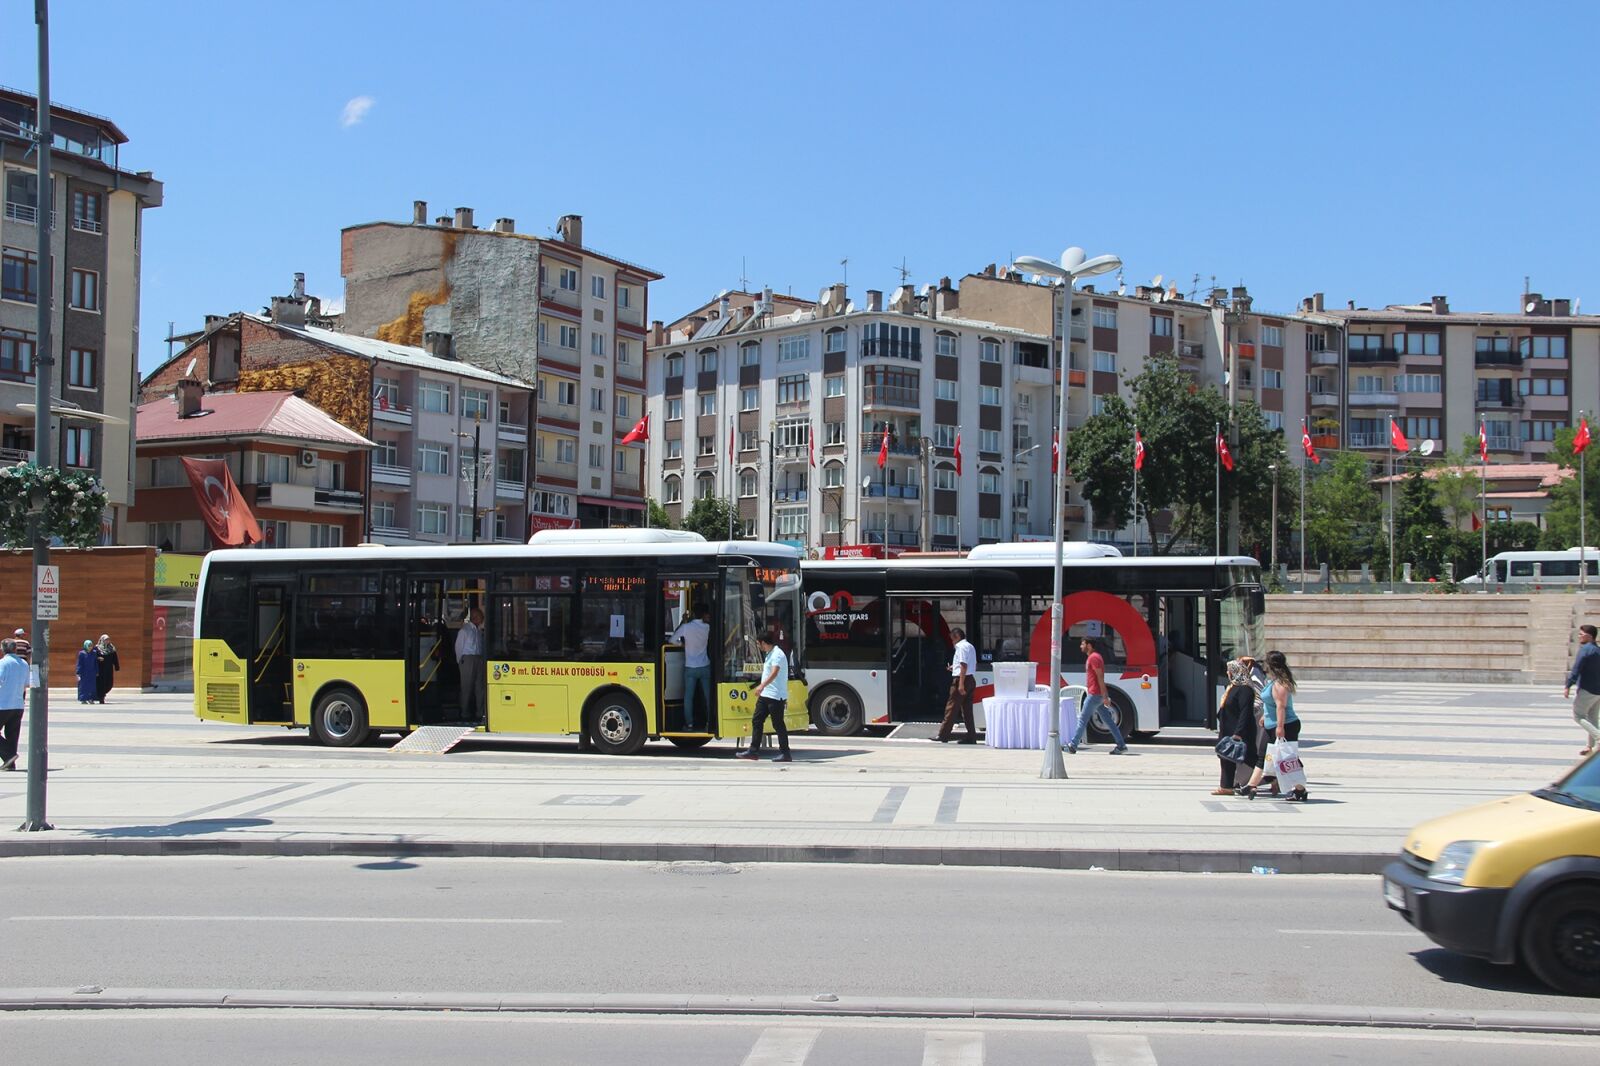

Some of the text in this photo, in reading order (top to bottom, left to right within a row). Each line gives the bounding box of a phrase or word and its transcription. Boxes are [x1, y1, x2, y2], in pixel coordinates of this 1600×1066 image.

[819, 613, 869, 621] HISTORIC YEARS
[818, 632, 849, 640] ISUZU
[511, 666, 516, 676] 9
[531, 665, 549, 676] ÖZEL
[550, 666, 570, 676] HALK
[571, 665, 605, 677] OTOBÜSÜ
